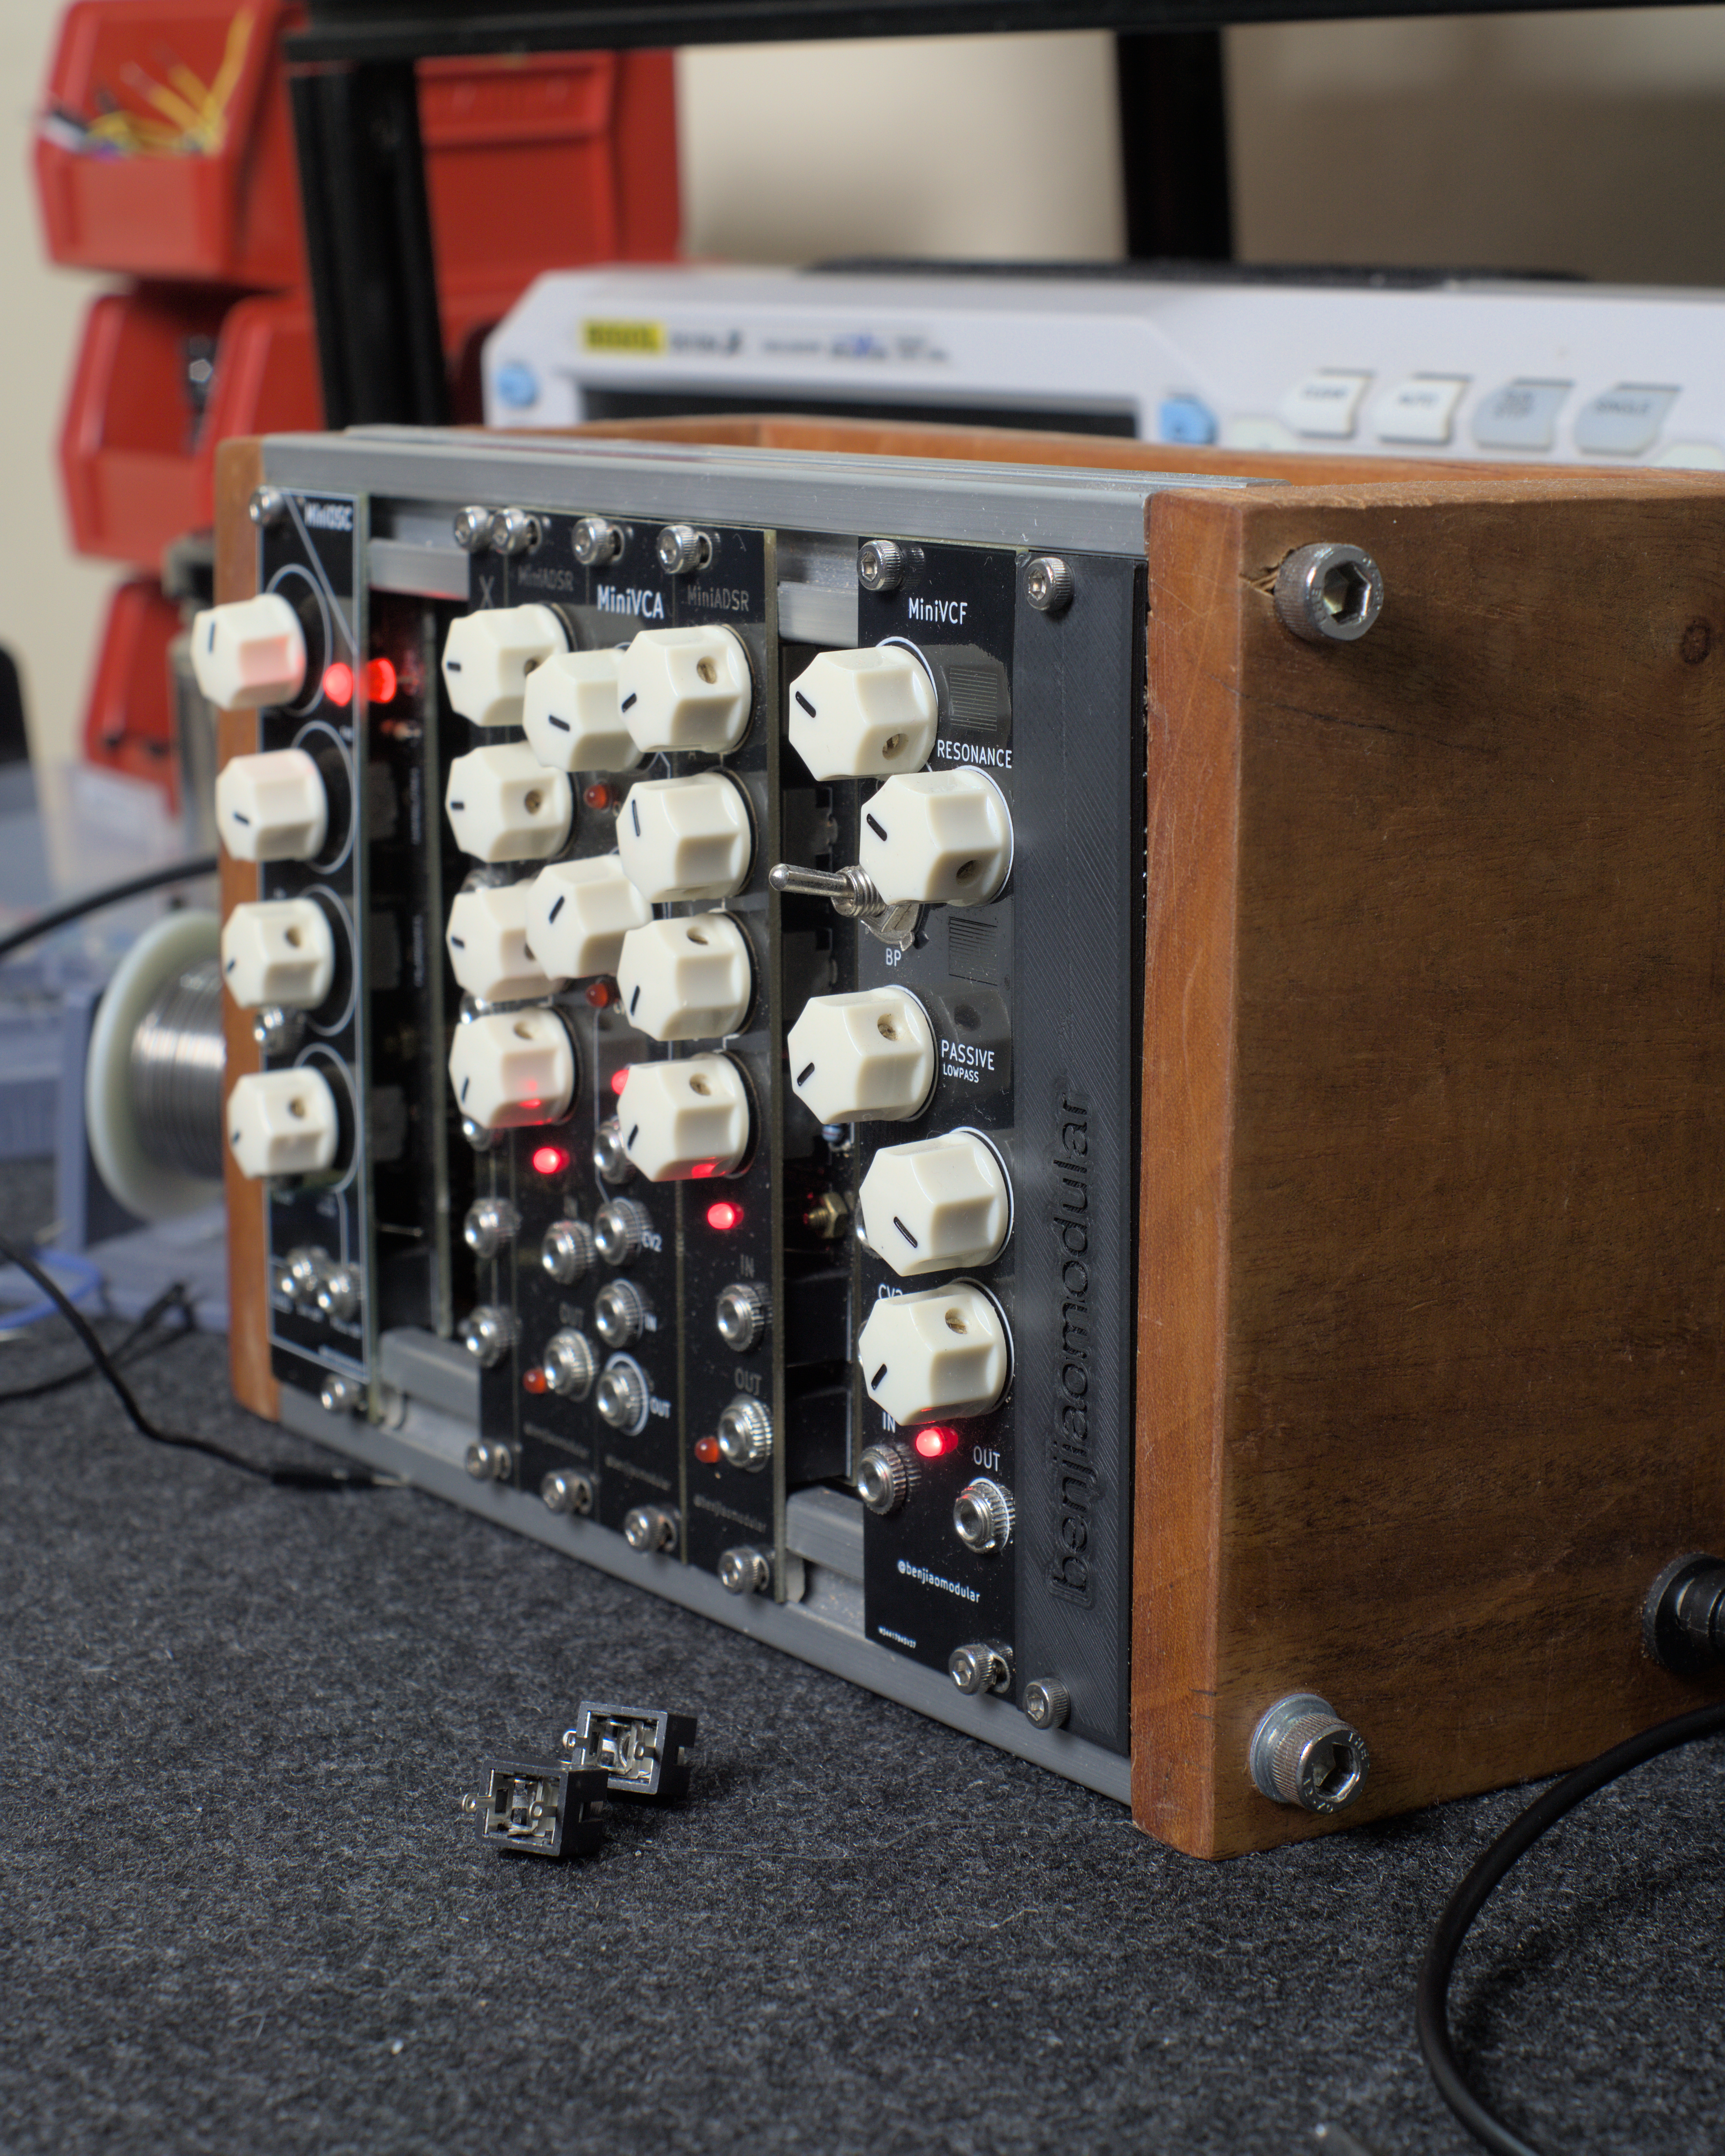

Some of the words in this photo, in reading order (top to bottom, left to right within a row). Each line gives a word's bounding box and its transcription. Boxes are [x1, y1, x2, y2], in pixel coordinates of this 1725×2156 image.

[597, 584, 664, 619] MiniVCA
[687, 585, 749, 612] MiniADSR
[909, 597, 968, 625] MiniVCF
[937, 739, 1012, 769] RESONANCE
[885, 947, 901, 967] BP
[941, 1039, 995, 1071] PASSIVE
[943, 1062, 979, 1083] LOWPASS
[642, 1232, 662, 1253] CV2
[740, 1254, 755, 1278] IN
[1054, 1091, 1098, 1591] benjiaomodular
[734, 1367, 762, 1396] OUT
[650, 1396, 671, 1419] OUT
[882, 1411, 896, 1434] IN
[973, 1446, 1000, 1472] OUT
[897, 1559, 980, 1603] @benjiaomodular
